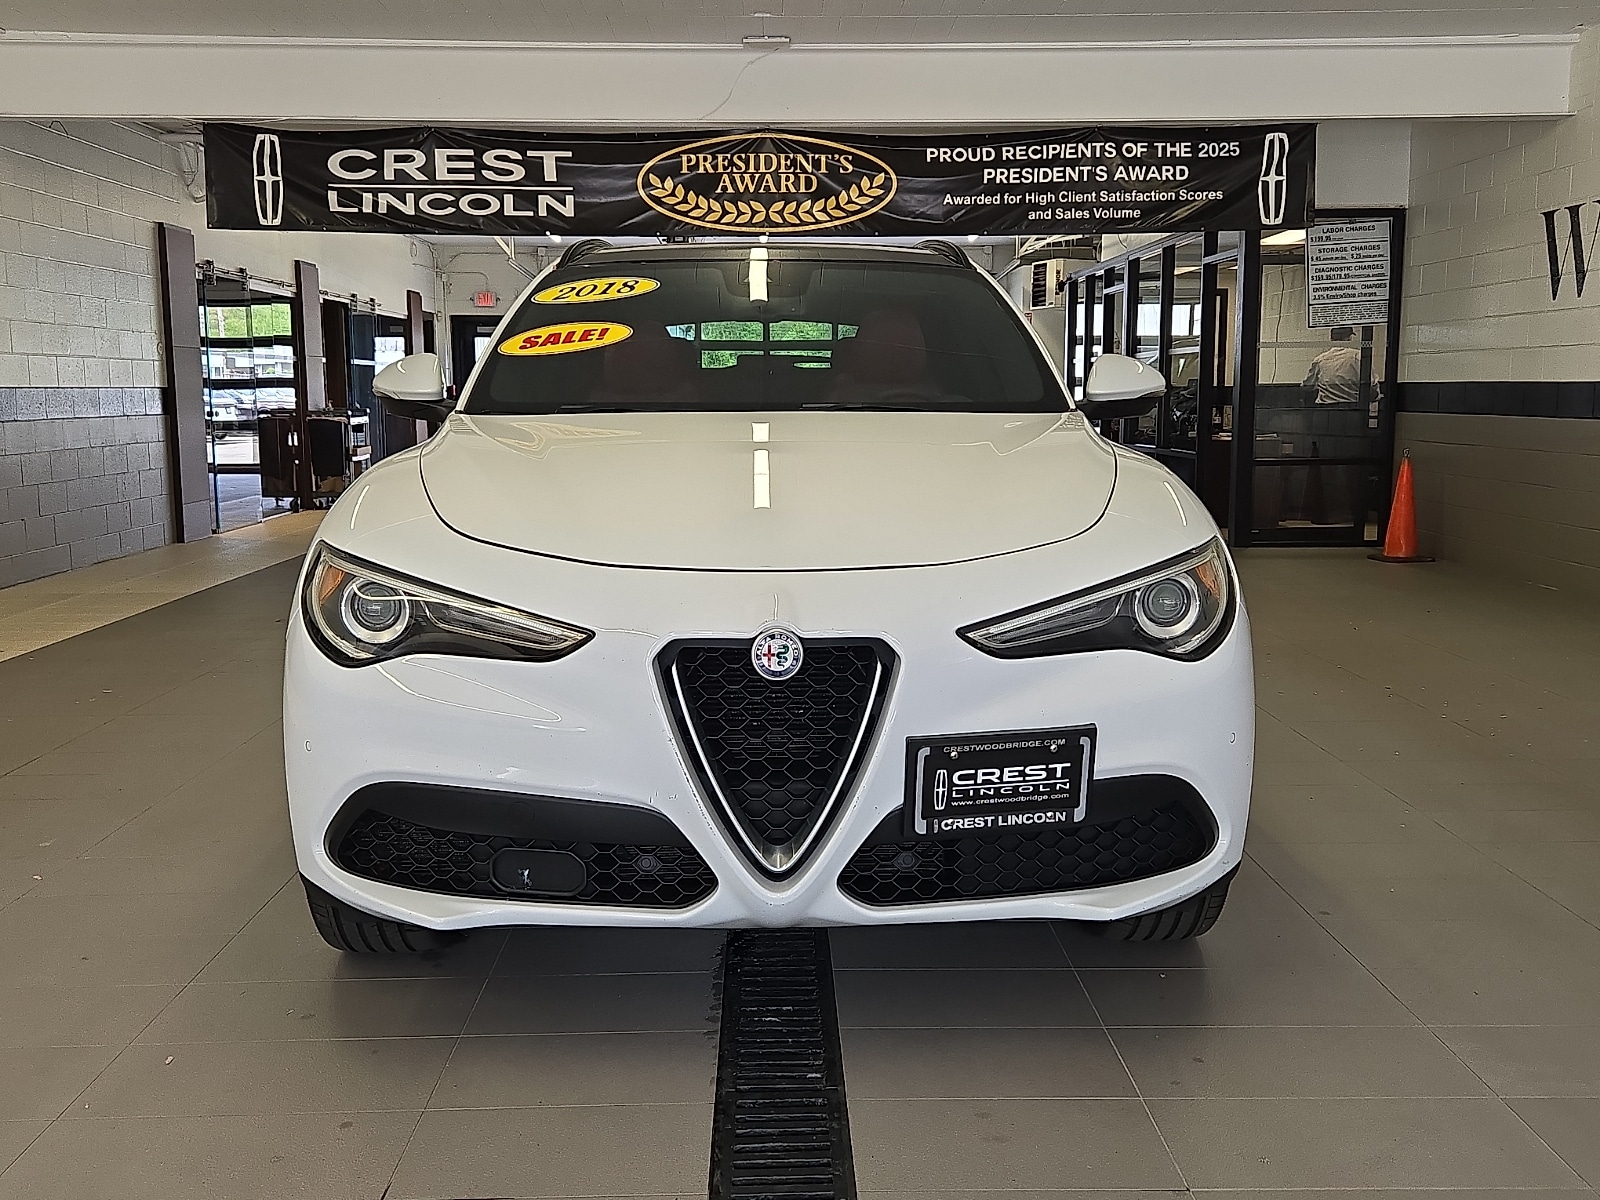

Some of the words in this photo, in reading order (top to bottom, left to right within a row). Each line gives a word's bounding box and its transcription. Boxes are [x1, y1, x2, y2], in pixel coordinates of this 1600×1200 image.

[926, 147, 996, 163] PROUD
[1002, 142, 1117, 161] RECIPIENTS
[1122, 142, 1148, 158] OF
[1154, 142, 1192, 158] THE
[1198, 142, 1240, 157] 2025
[327, 148, 573, 182] CREST
[680, 153, 854, 174] PRESIDENT'S
[715, 174, 818, 194] AWARD
[983, 166, 1108, 184] PRESIDENT'S
[1113, 166, 1189, 181] AWARD
[327, 190, 575, 217] LINCOLN
[943, 193, 1000, 205] Awarded
[1004, 193, 1022, 204] for
[1026, 192, 1055, 206] High
[1058, 191, 1097, 203] Client
[1100, 190, 1175, 202] Satisfaction
[1179, 189, 1223, 201] Scores
[1028, 208, 1051, 220] and
[1055, 208, 1090, 219] Sales
[1093, 207, 1141, 219] Volume
[1350, 244, 1381, 252] CHARGES
[1314, 265, 1353, 273] DIAGNOSTIC
[552, 280, 640, 301] 2018
[518, 327, 611, 350] SALE!
[943, 738, 1066, 753] CRESTWOODBRIDGE.COM
[952, 763, 1071, 785] CREST
[952, 782, 1070, 798] LINCOLN
[951, 793, 1070, 807] www.crestwoodbridge.com
[941, 816, 995, 831] CREST
